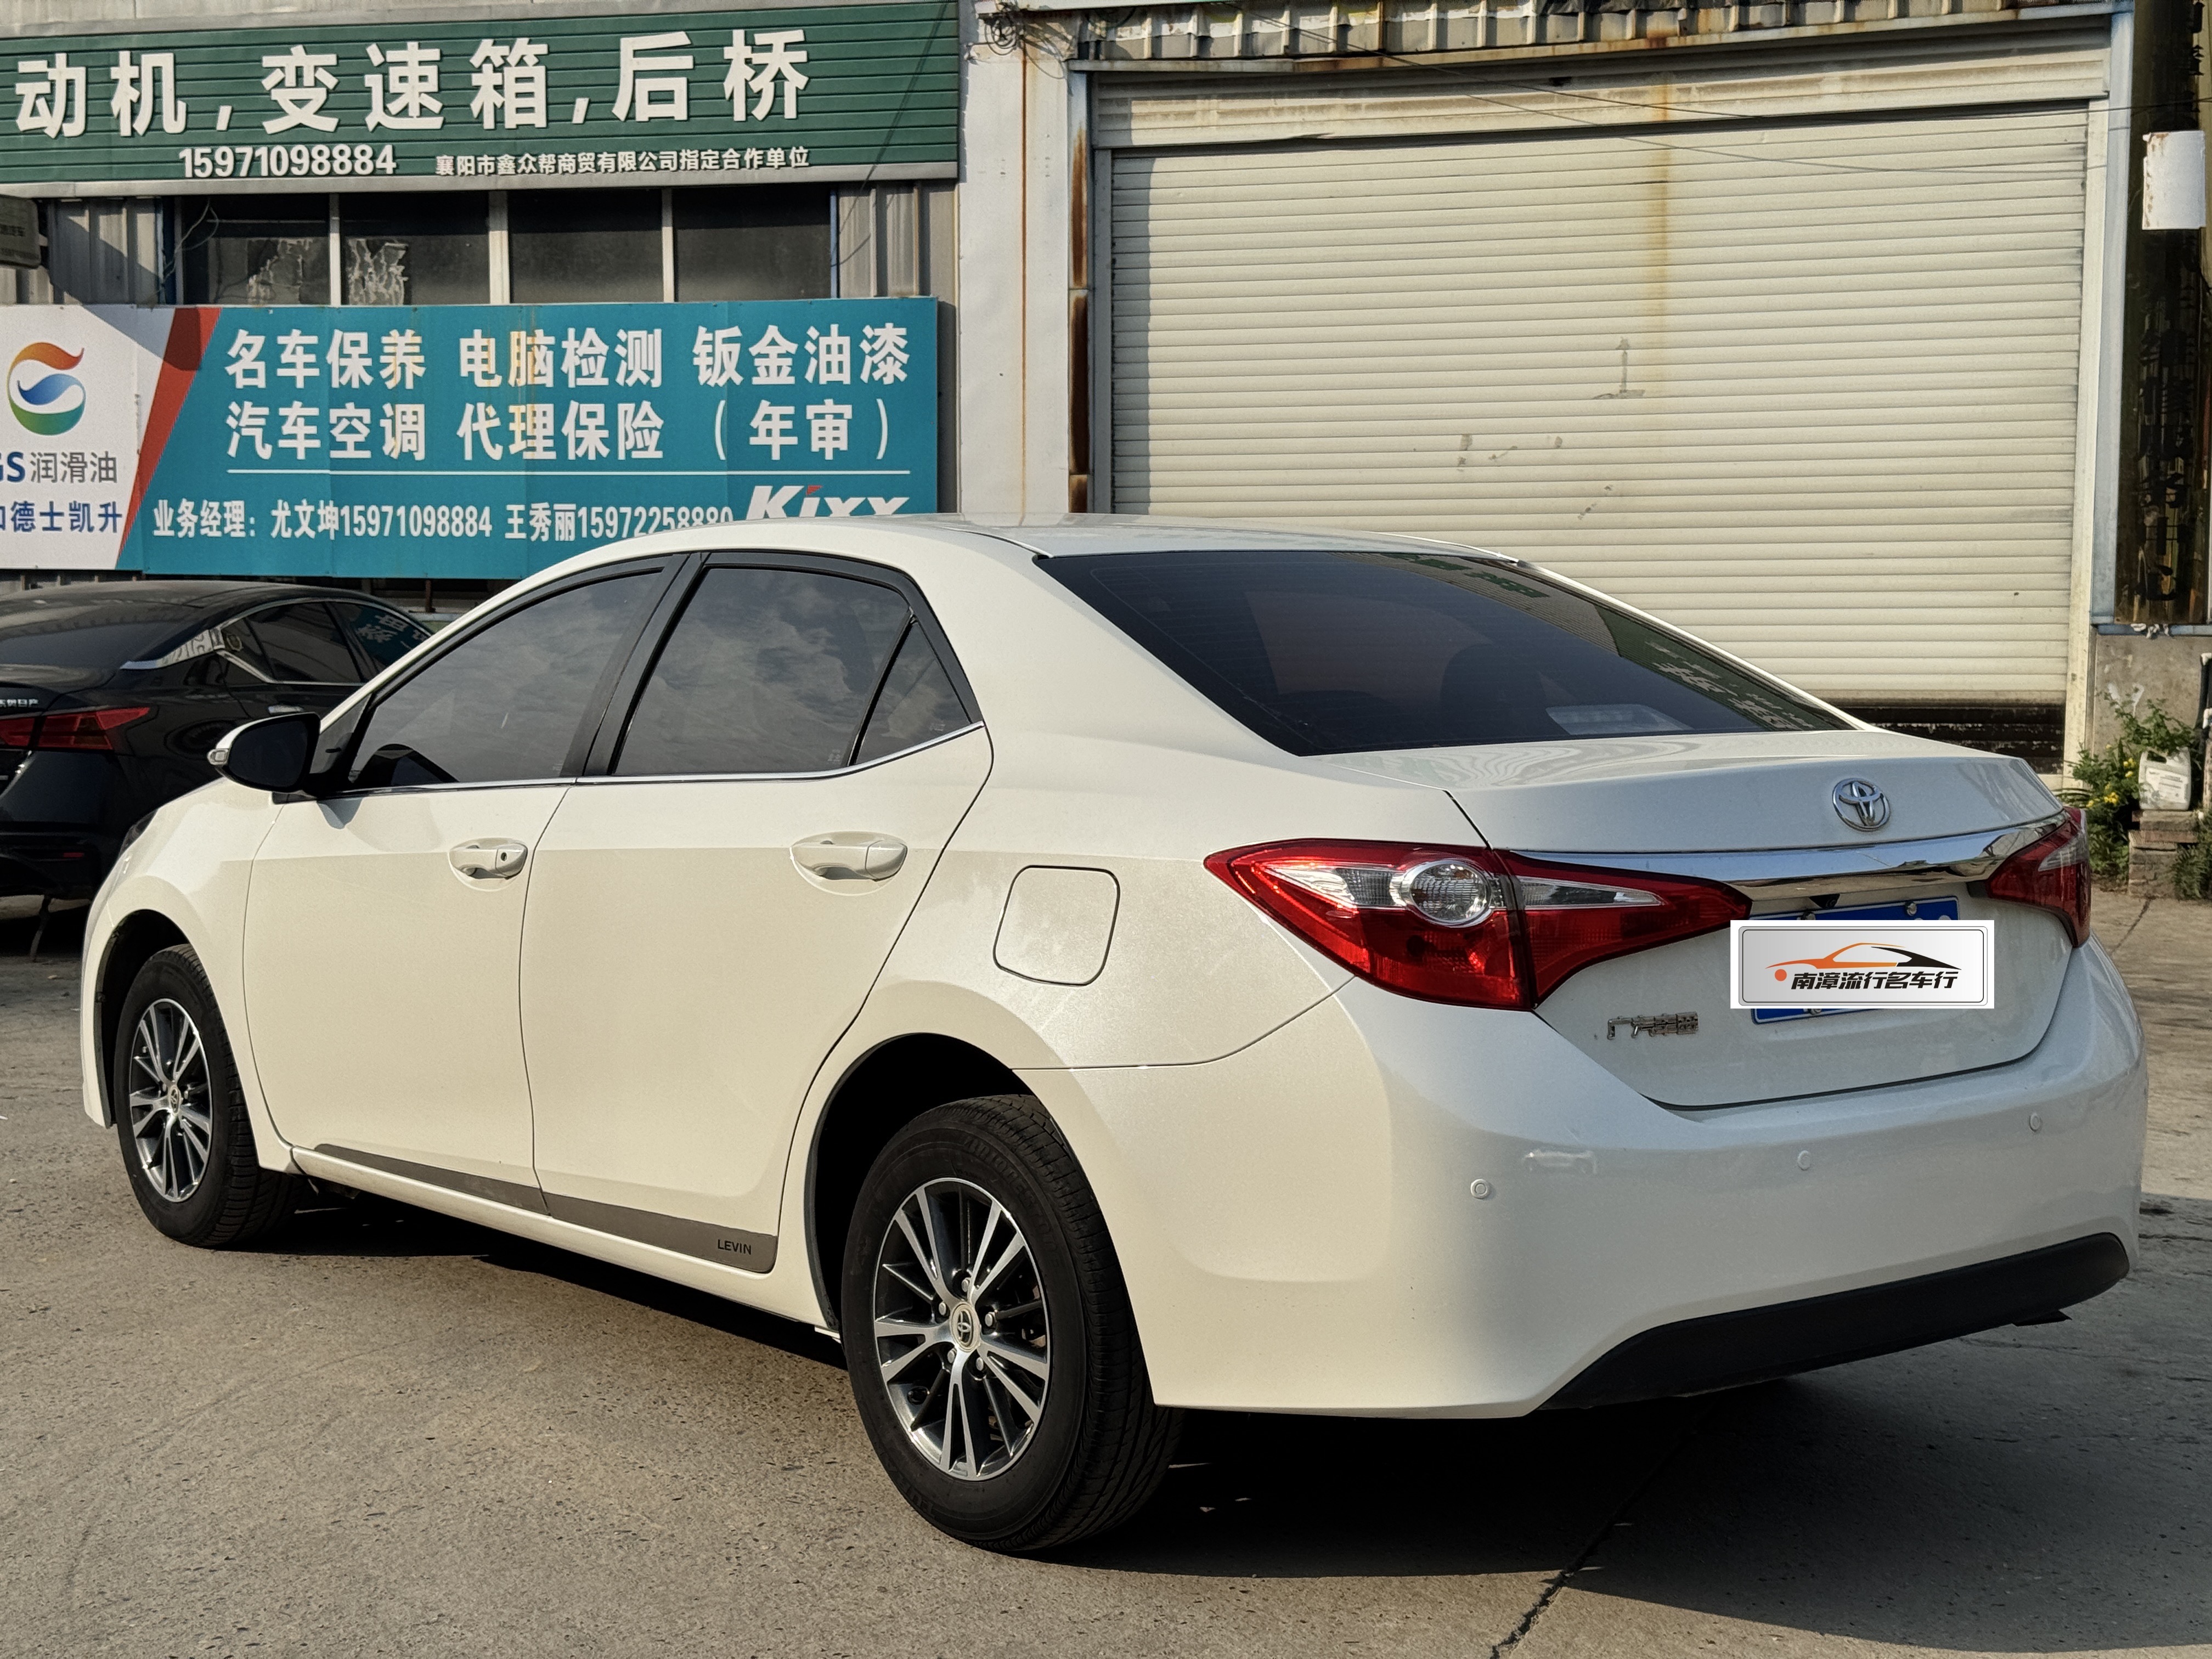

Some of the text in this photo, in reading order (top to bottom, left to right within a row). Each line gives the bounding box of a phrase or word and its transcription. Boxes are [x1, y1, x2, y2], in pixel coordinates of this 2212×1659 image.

[179, 144, 810, 178] 15971098884 襄阳市鑫众帮商贸有限公司指定合作单位
[225, 322, 910, 390] 名车保养 电脑检测 钣金油漆
[226, 401, 426, 461] 汽车空调
[456, 400, 664, 461] 代理保险
[0, 452, 118, 484] S润滑油
[0, 500, 122, 535] 德士凯升
[718, 1239, 752, 1255] LEVIN
